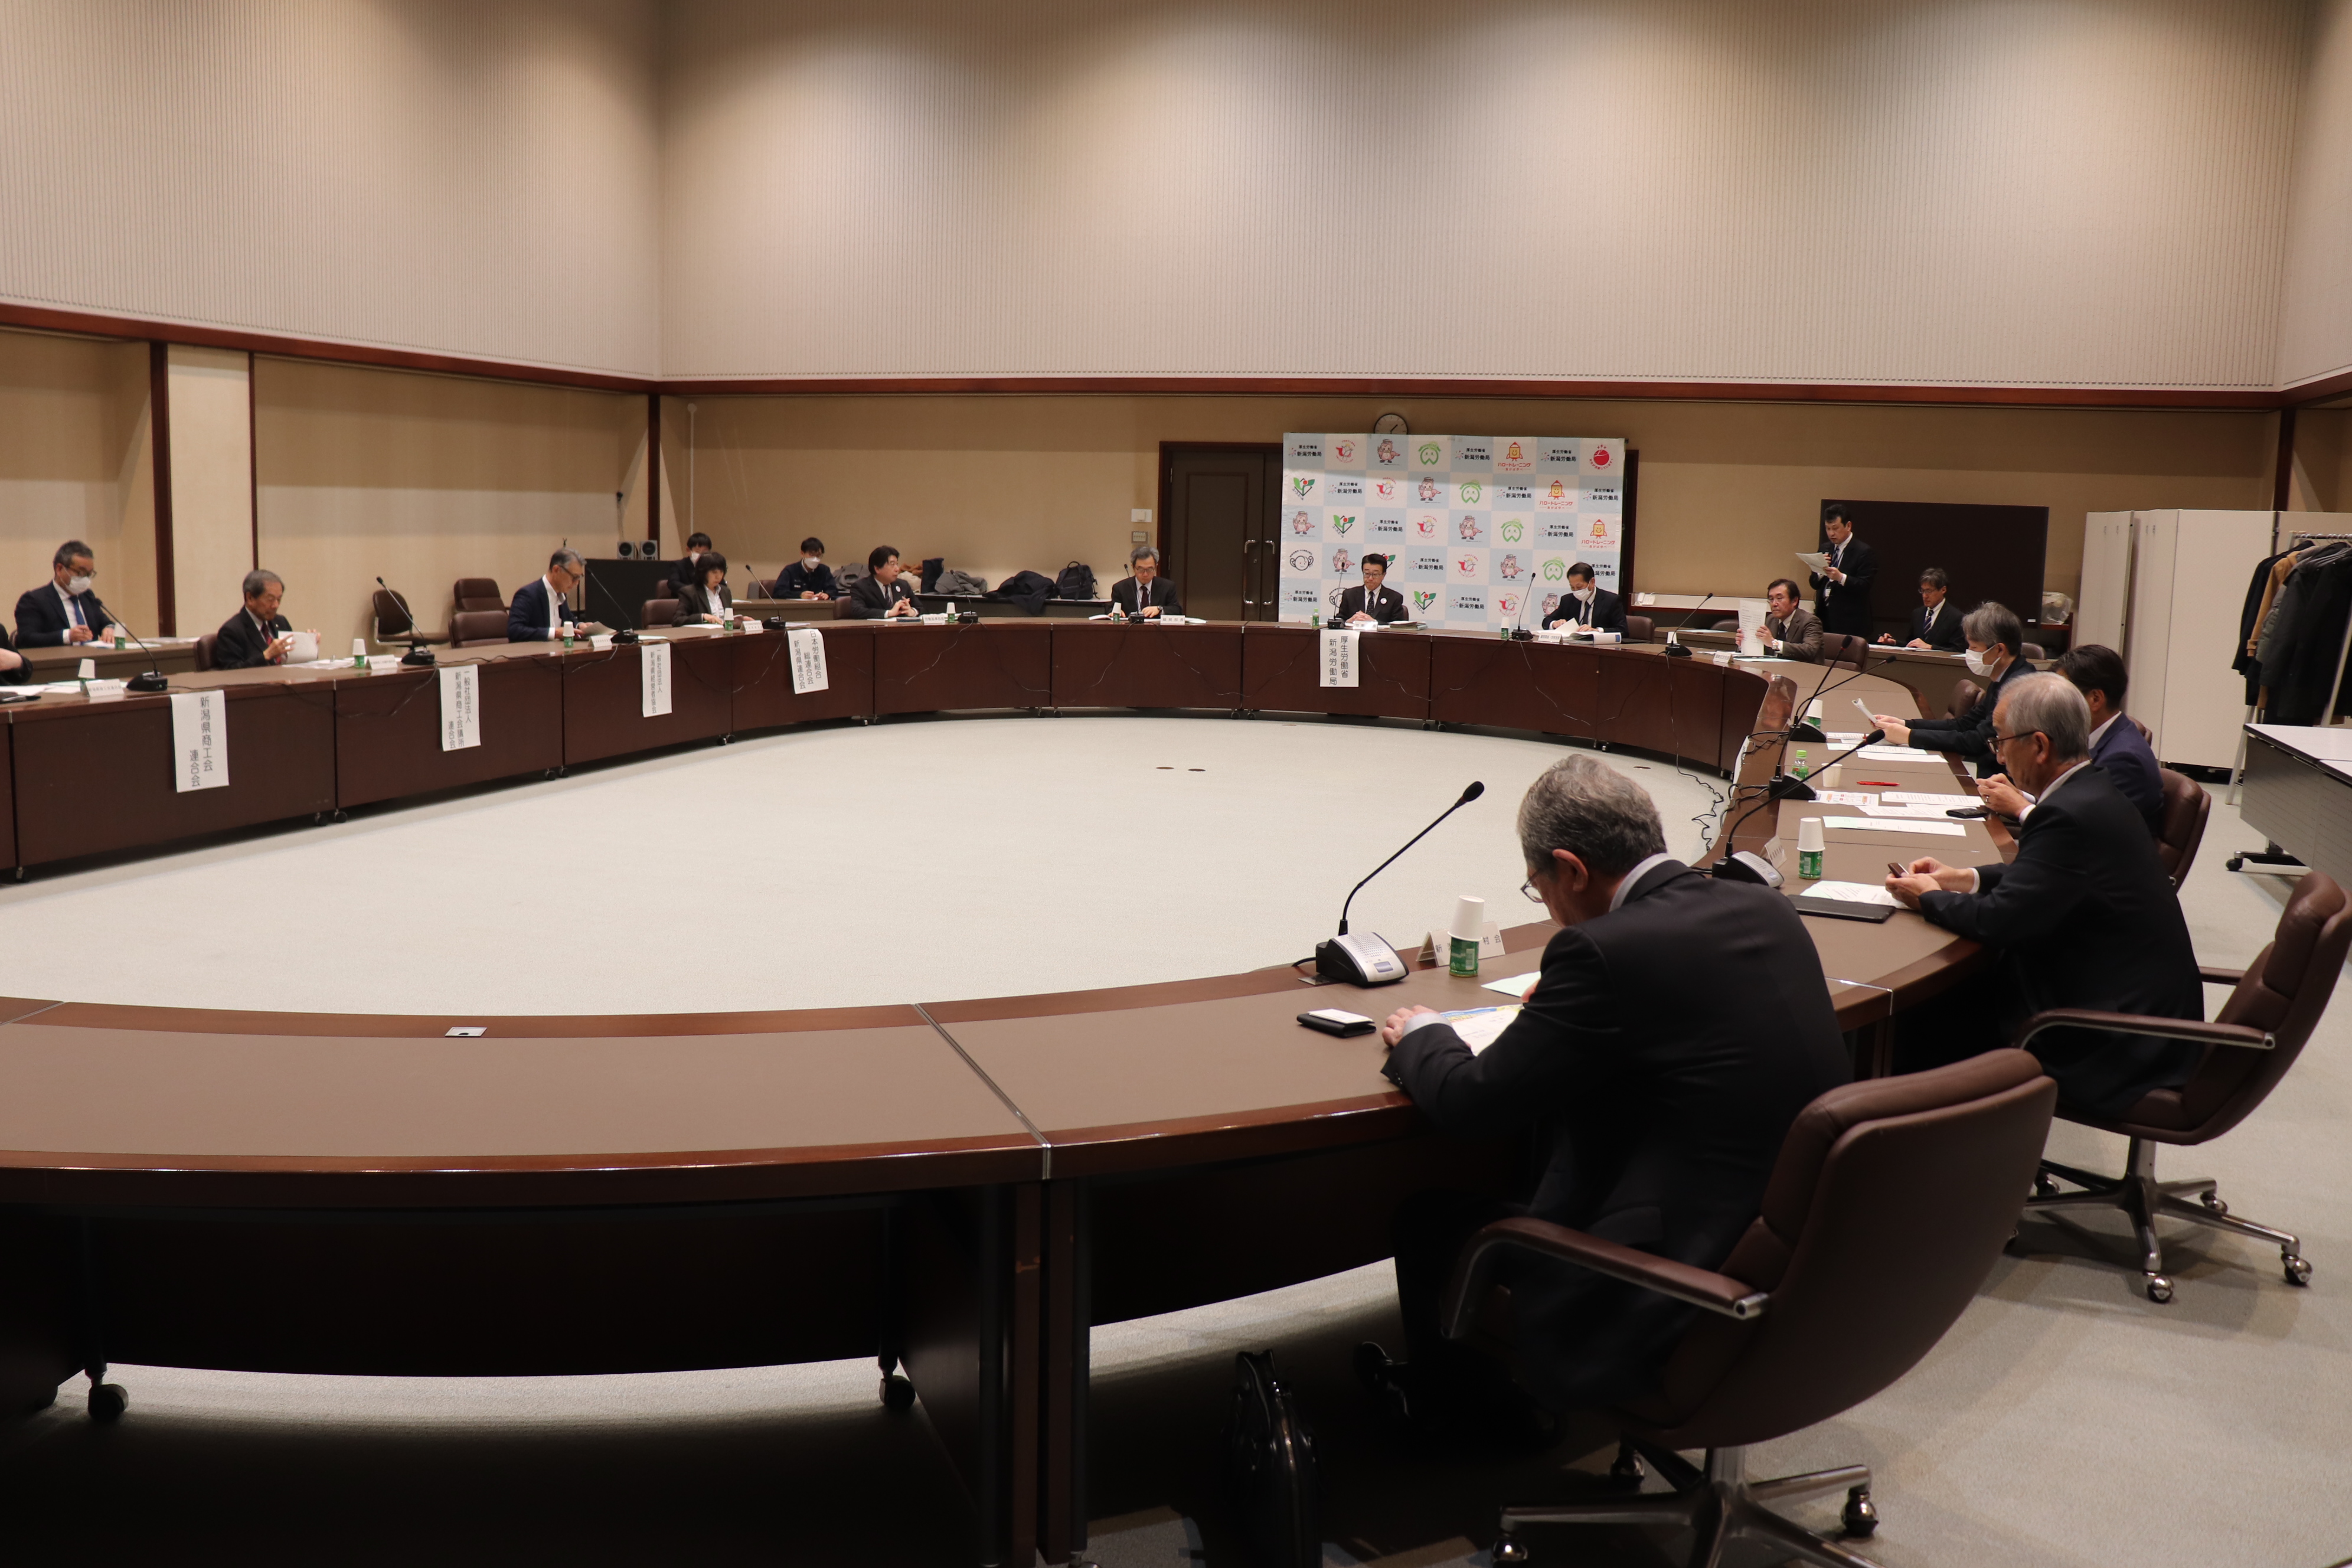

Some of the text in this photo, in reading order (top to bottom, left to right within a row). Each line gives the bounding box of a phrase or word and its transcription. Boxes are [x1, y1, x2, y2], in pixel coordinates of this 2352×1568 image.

[794, 640, 806, 689] 新潟県連合会
[803, 652, 814, 684] 総連合会
[810, 631, 822, 678] 日本労働組合
[1329, 638, 1337, 685] 新潟労働局
[1340, 635, 1348, 678] 厚生労働省
[455, 672, 465, 747] 新潟県商工会議所
[200, 696, 213, 772] 新潟県商工会
[190, 749, 200, 787] 連合会
